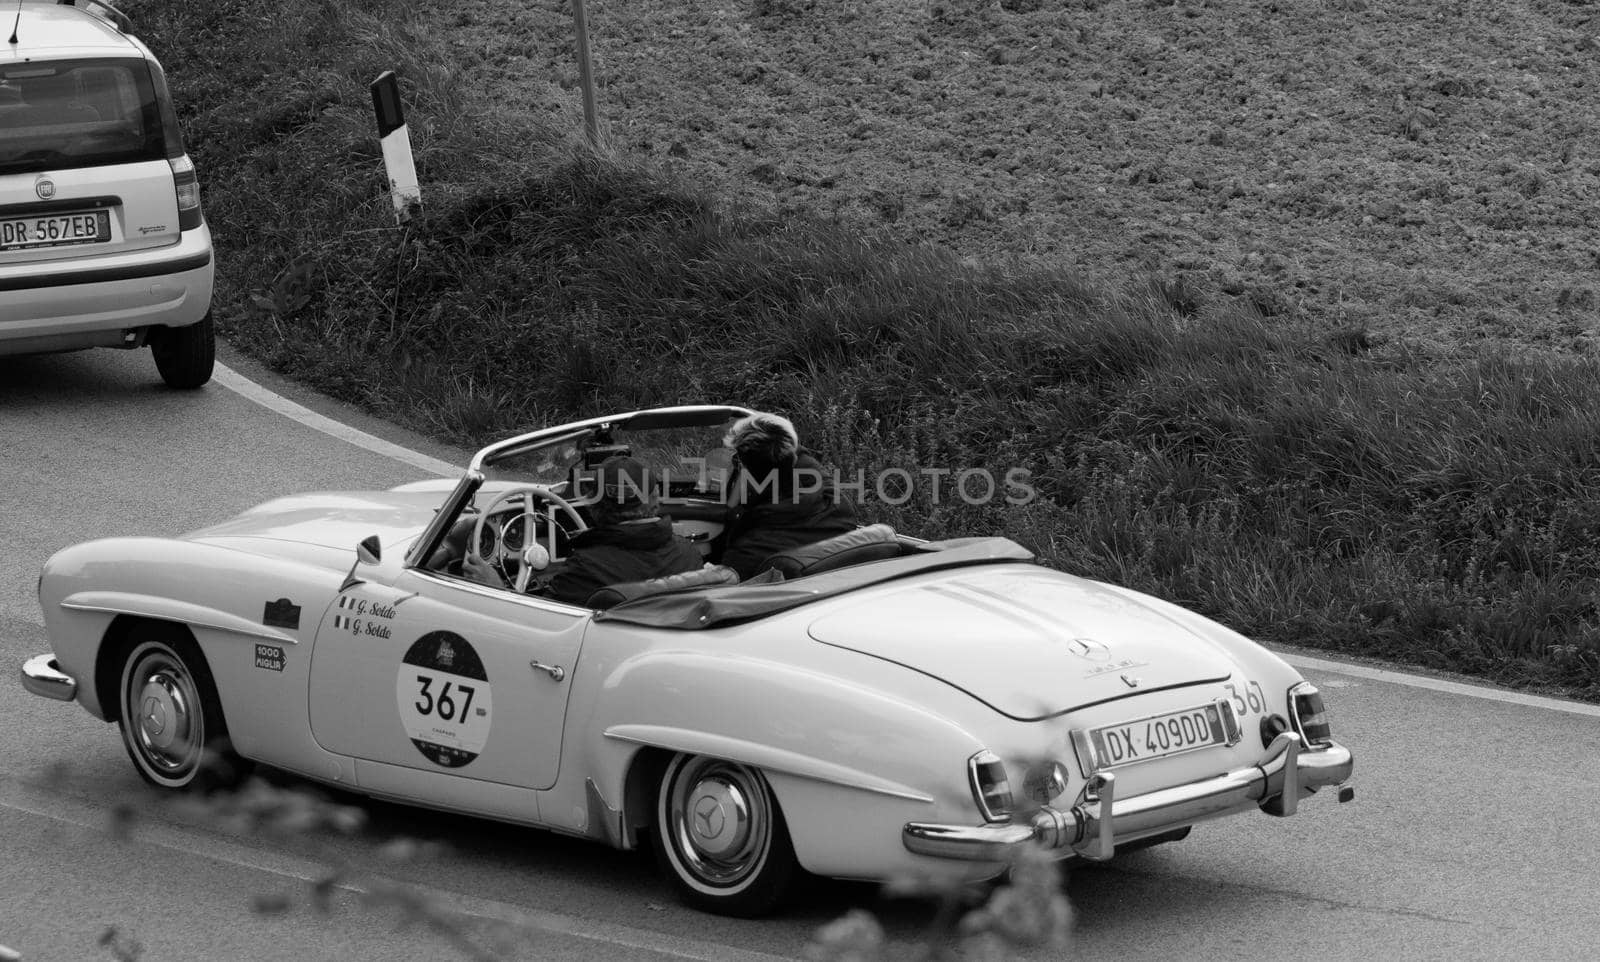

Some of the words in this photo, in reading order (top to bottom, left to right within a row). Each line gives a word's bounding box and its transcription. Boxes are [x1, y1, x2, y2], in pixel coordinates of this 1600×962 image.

[3, 222, 27, 243] DR
[36, 215, 96, 241] 567EB
[357, 600, 367, 616] G.
[369, 602, 396, 620] Soldo
[353, 618, 363, 636] G.
[365, 621, 392, 639] Soldo
[256, 658, 281, 670] MIGLIA
[257, 646, 280, 658] 1000
[415, 674, 475, 724] 367
[1224, 680, 1267, 716] 367
[1106, 727, 1138, 761] DX
[1145, 712, 1210, 753] 409DD
